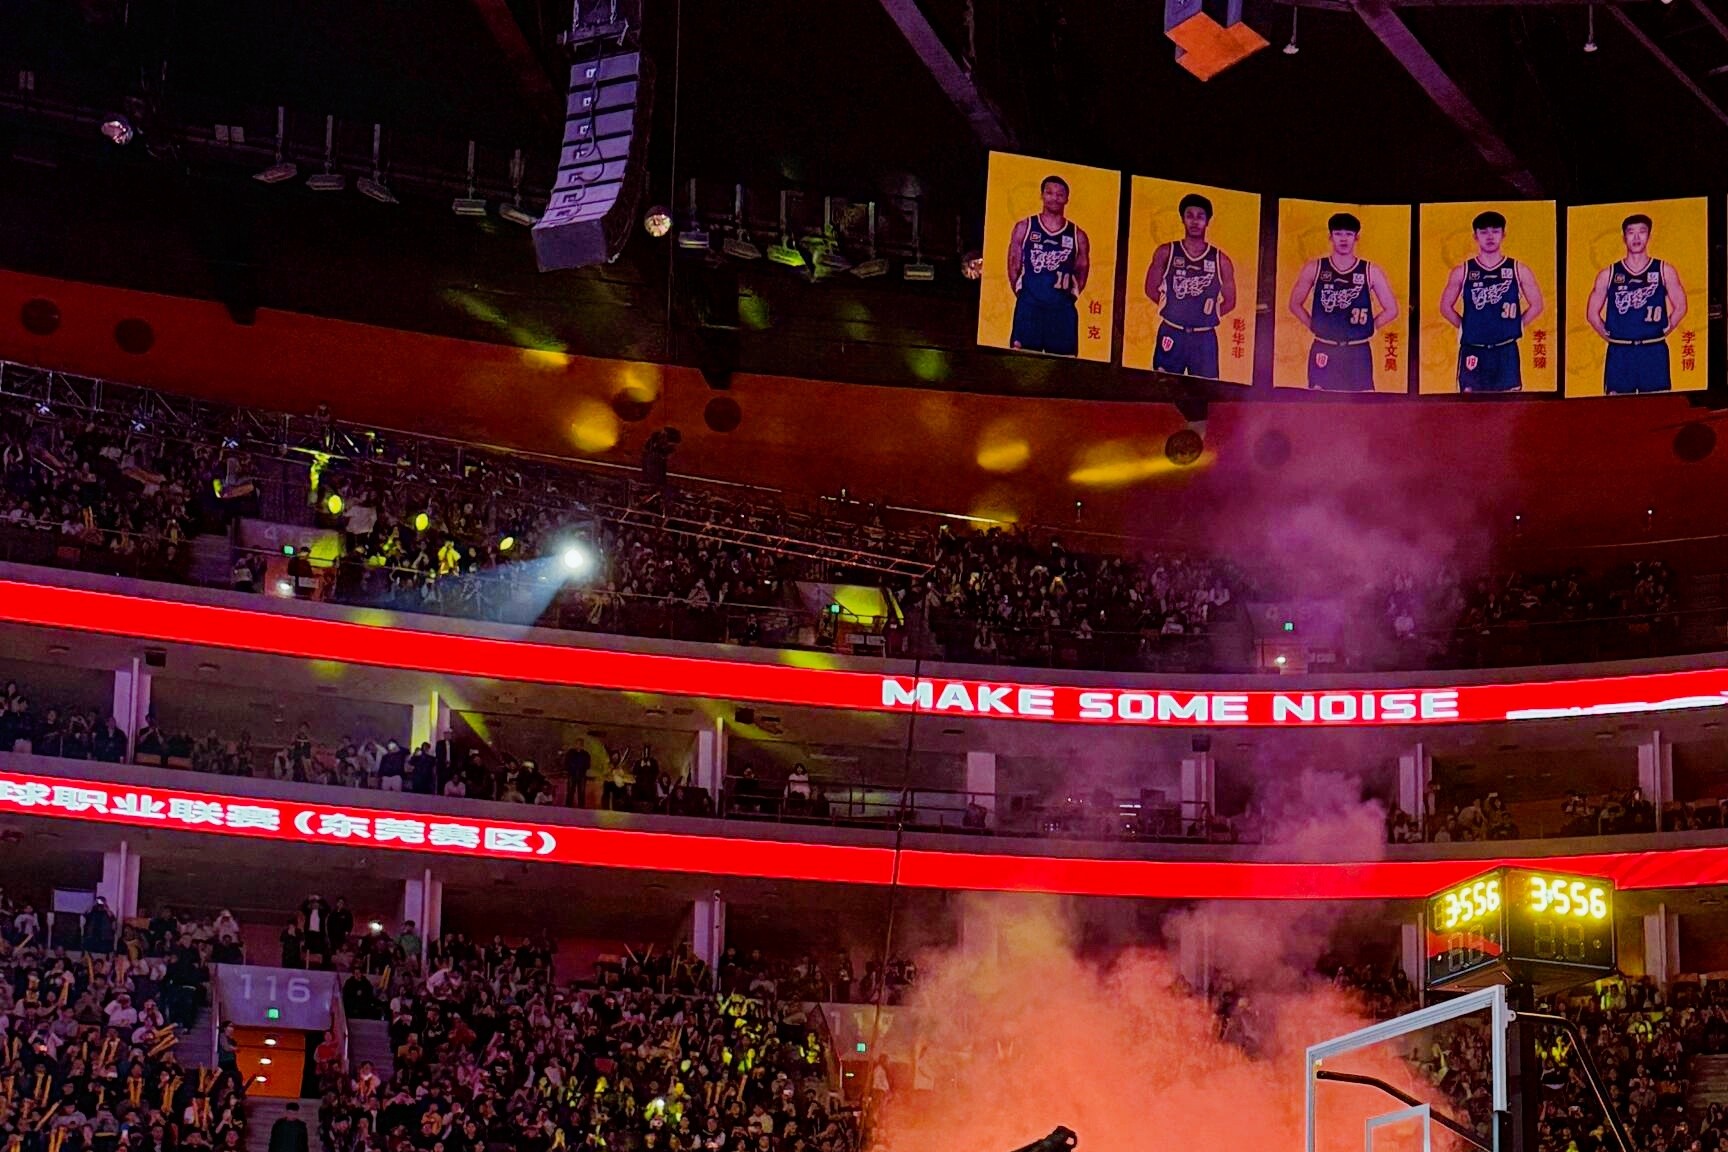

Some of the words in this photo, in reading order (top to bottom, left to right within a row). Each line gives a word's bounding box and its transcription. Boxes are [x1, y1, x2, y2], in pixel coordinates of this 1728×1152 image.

[1087, 300, 1102, 340] 伯克
[1350, 307, 1368, 325] 35
[1501, 302, 1517, 319] 30
[881, 678, 1055, 715] MAKE
[1079, 693, 1249, 721] SOME
[1273, 690, 1459, 721] NOISE
[241, 973, 311, 1003] 116
